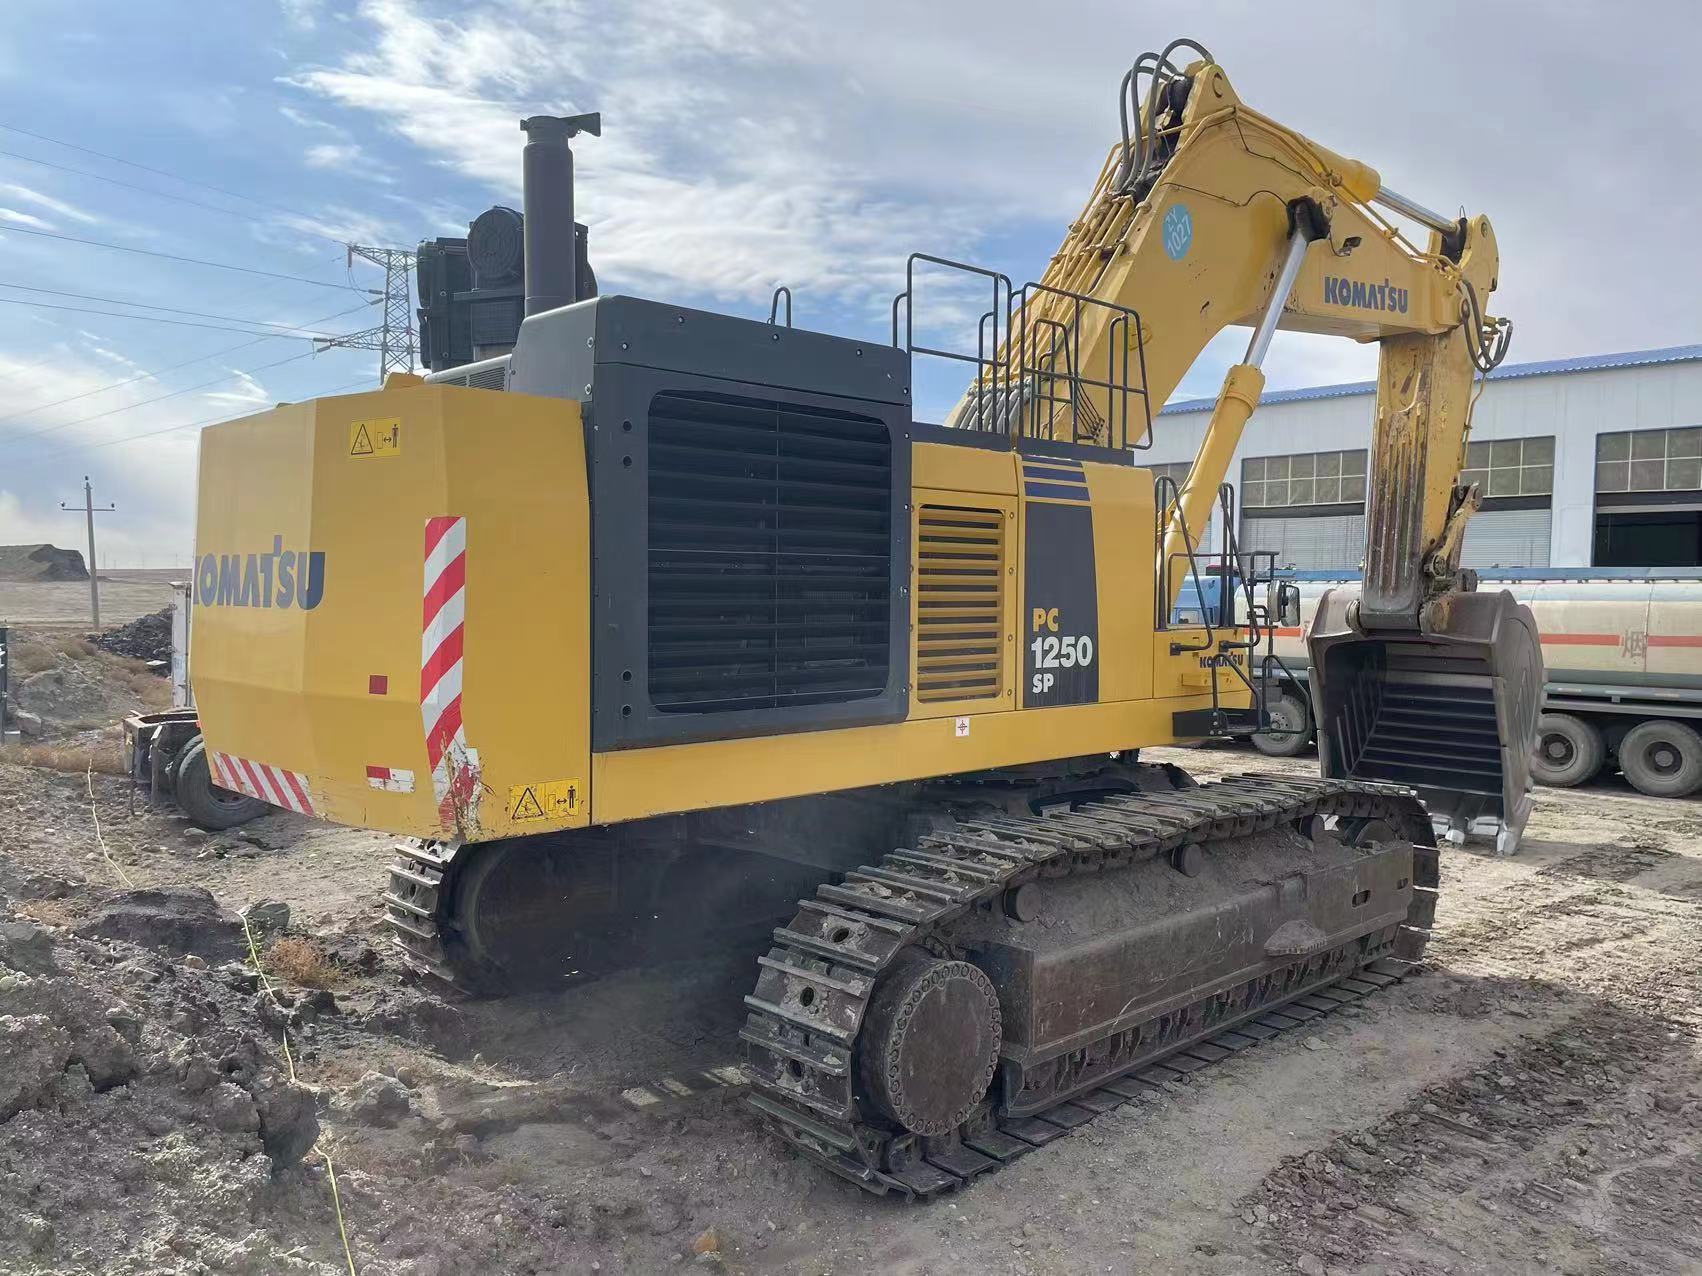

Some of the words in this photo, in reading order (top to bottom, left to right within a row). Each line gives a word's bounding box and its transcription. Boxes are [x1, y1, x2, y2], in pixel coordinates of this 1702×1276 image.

[1167, 214, 1191, 256] 1027
[1324, 276, 1409, 314] KOMATSU
[1032, 607, 1059, 632] PC
[1031, 635, 1093, 669] 1250
[1621, 629, 1646, 658] 烟
[1032, 673, 1055, 694] SP
